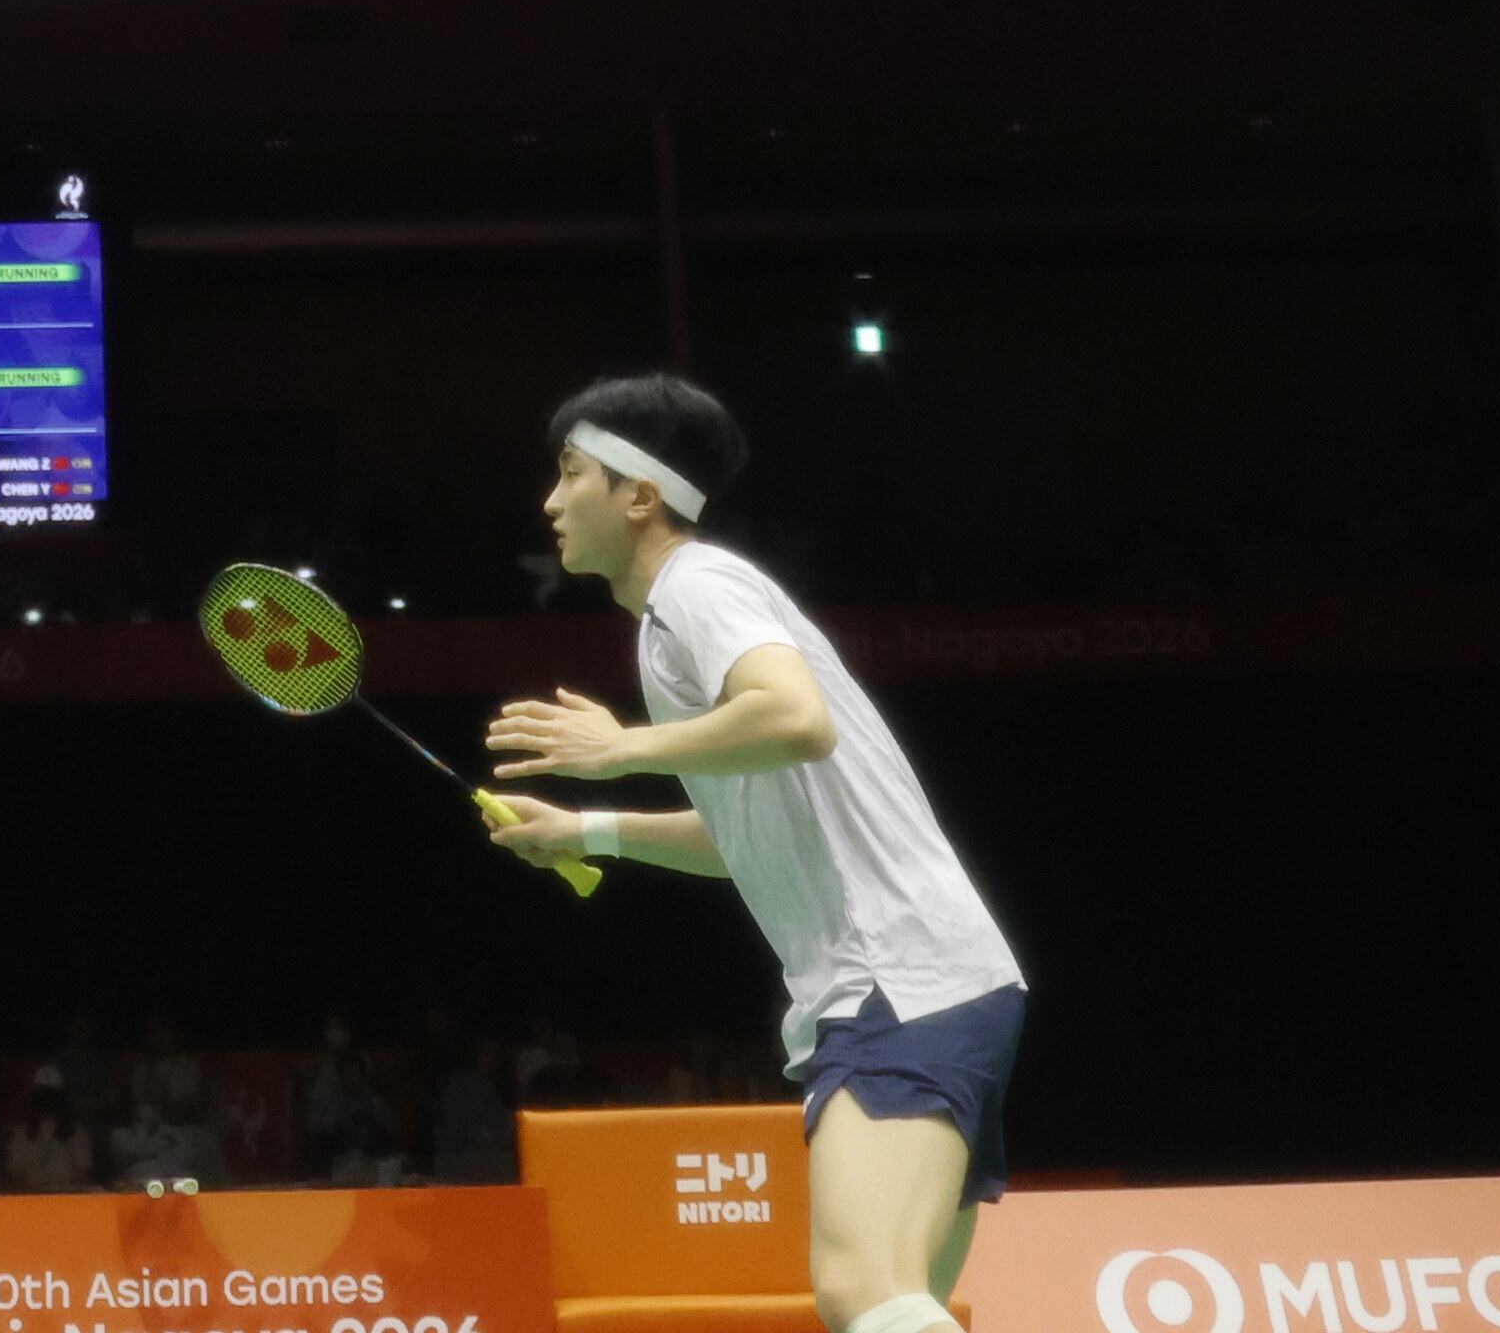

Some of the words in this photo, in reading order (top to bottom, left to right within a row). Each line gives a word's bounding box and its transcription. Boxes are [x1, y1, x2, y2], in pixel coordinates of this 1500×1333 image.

[1, 483, 39, 496] CHEN
[51, 504, 95, 521] 2026
[675, 1152, 768, 1193] ニトリ
[677, 1200, 771, 1224] NITORI
[85, 1267, 209, 1309] Asian
[223, 1269, 385, 1307] Games
